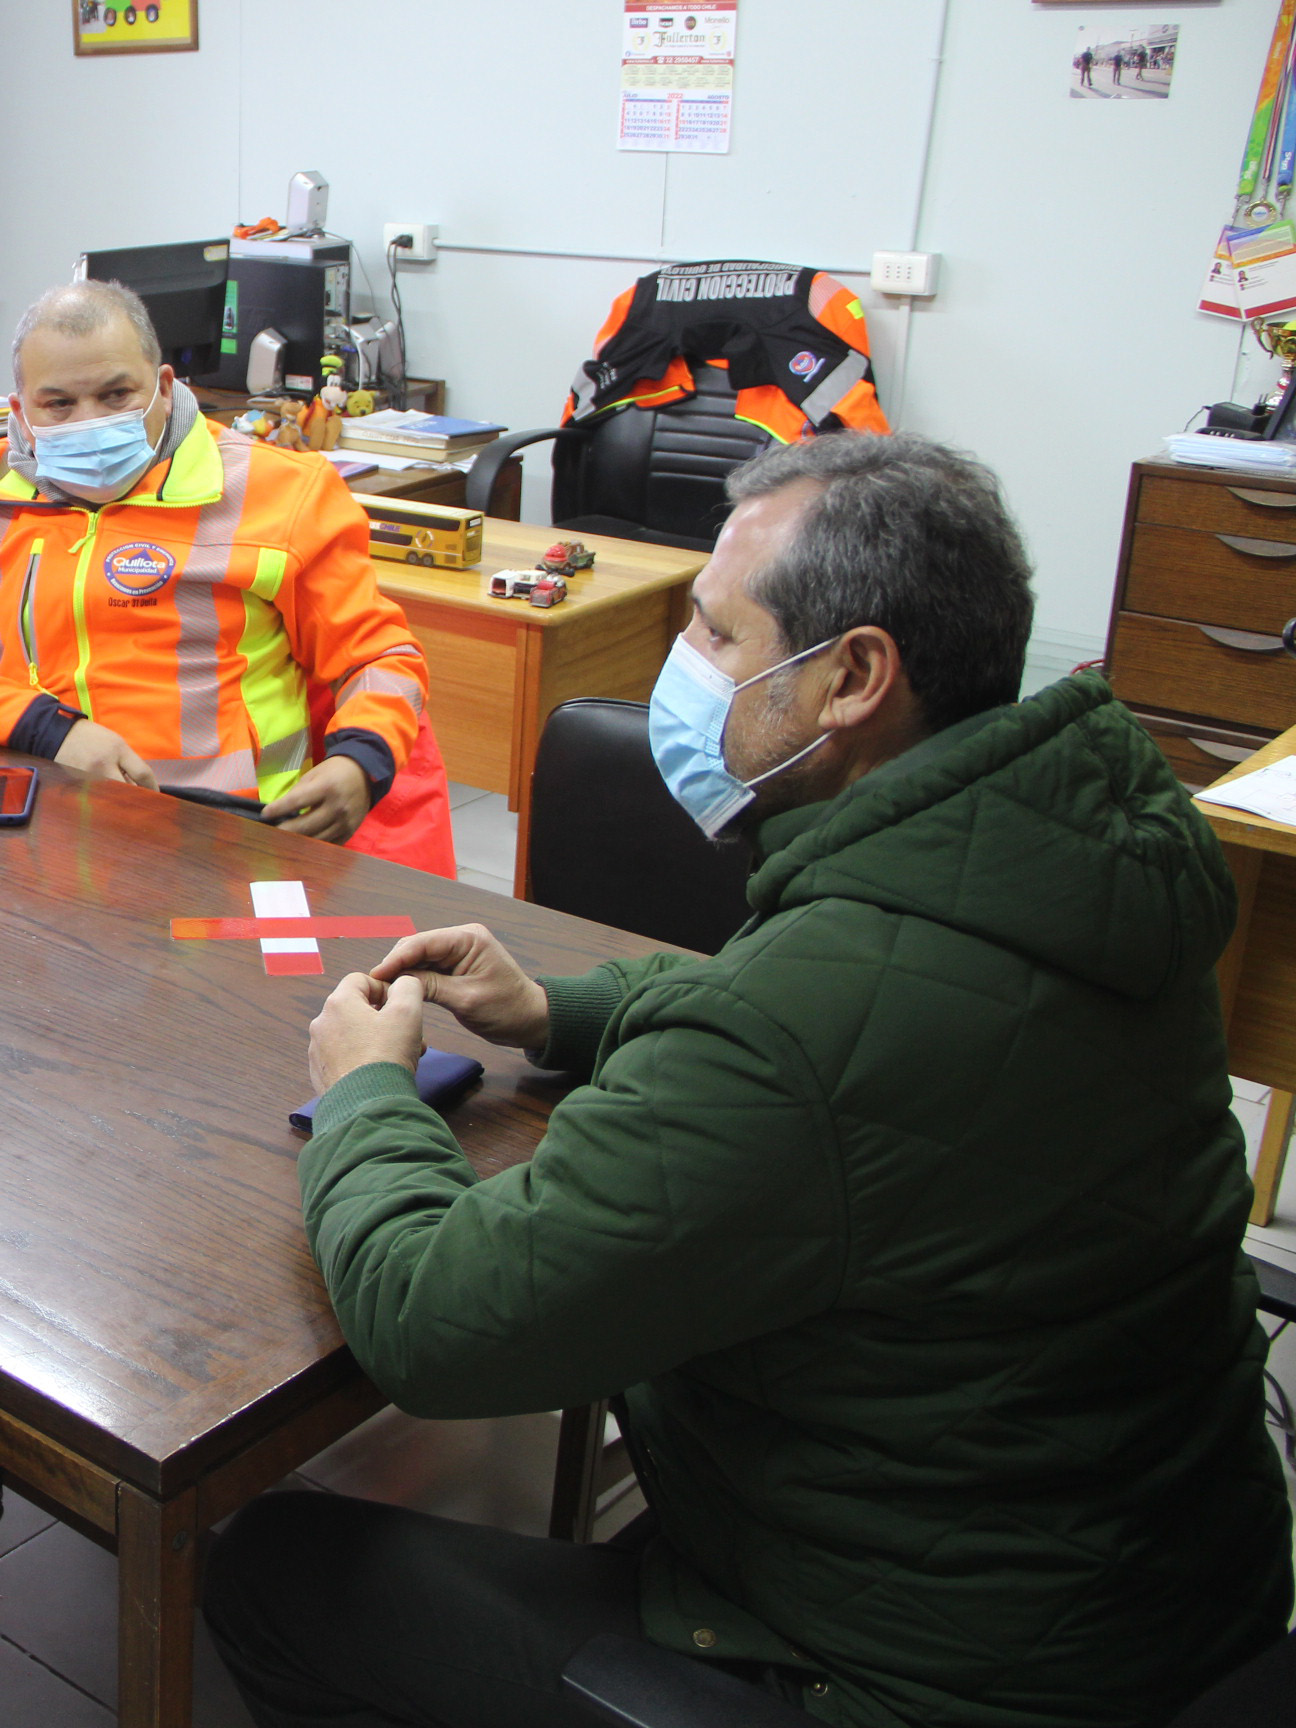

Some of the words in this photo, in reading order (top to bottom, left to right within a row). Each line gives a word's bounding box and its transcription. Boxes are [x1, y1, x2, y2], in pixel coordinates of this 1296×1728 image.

[654, 31, 705, 48] Fullerton
[708, 263, 722, 273] DE
[656, 278, 697, 302] CIVIL
[697, 273, 798, 300] PROTECCION
[113, 557, 167, 569] Quillota
